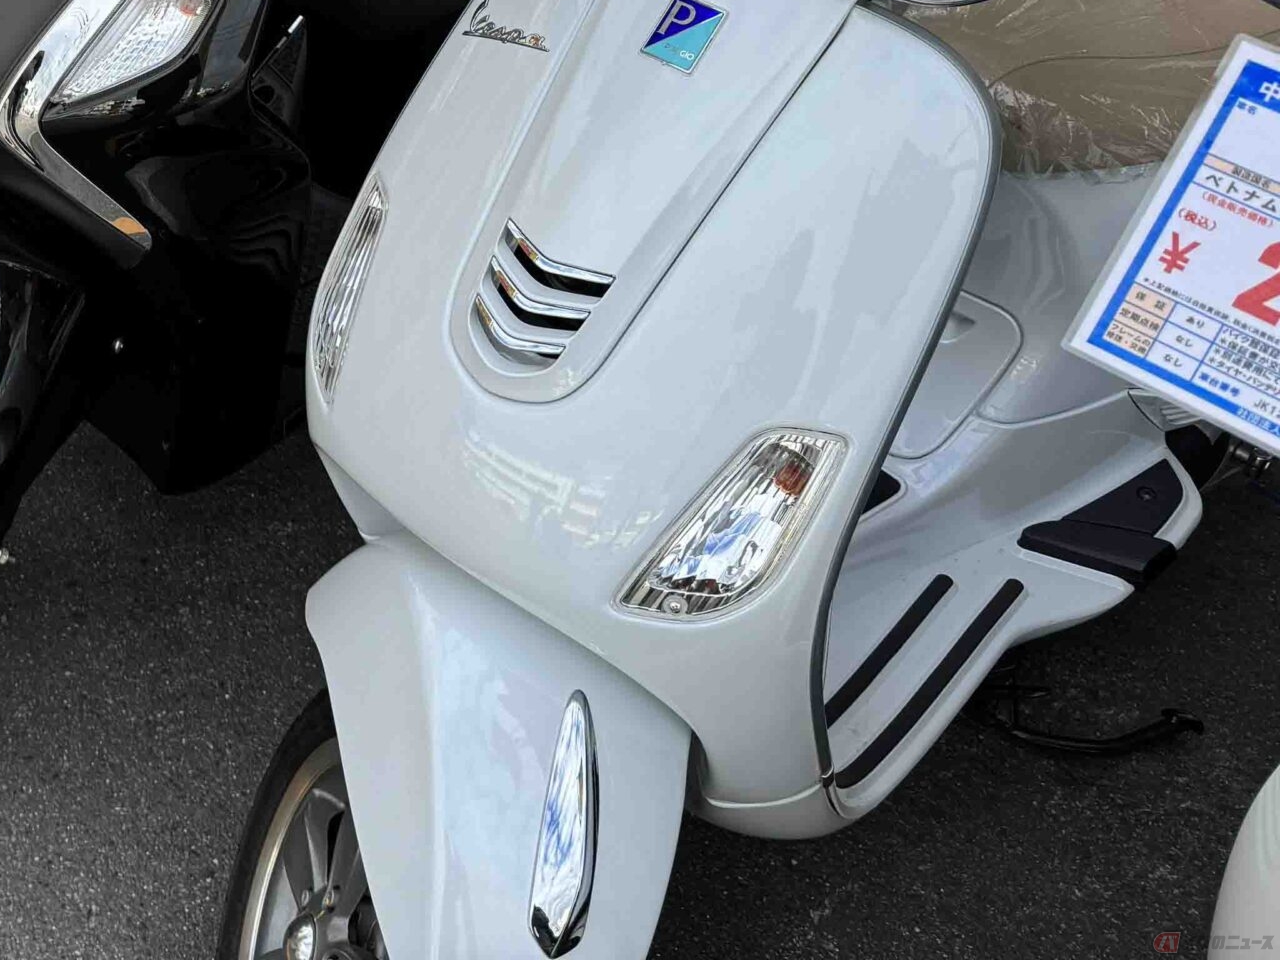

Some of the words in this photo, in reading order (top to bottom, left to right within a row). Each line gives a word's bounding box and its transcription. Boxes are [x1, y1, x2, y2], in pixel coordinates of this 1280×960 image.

[656, 0, 697, 35] P
[1205, 174, 1278, 213] ベトナム
[1178, 207, 1217, 232] (税込)
[1158, 231, 1201, 276] ¥
[1119, 307, 1161, 331] 定期点検
[1185, 315, 1206, 329] あり
[1111, 323, 1151, 347] フレームの
[1176, 334, 1193, 348] なし
[1163, 353, 1183, 368] なし
